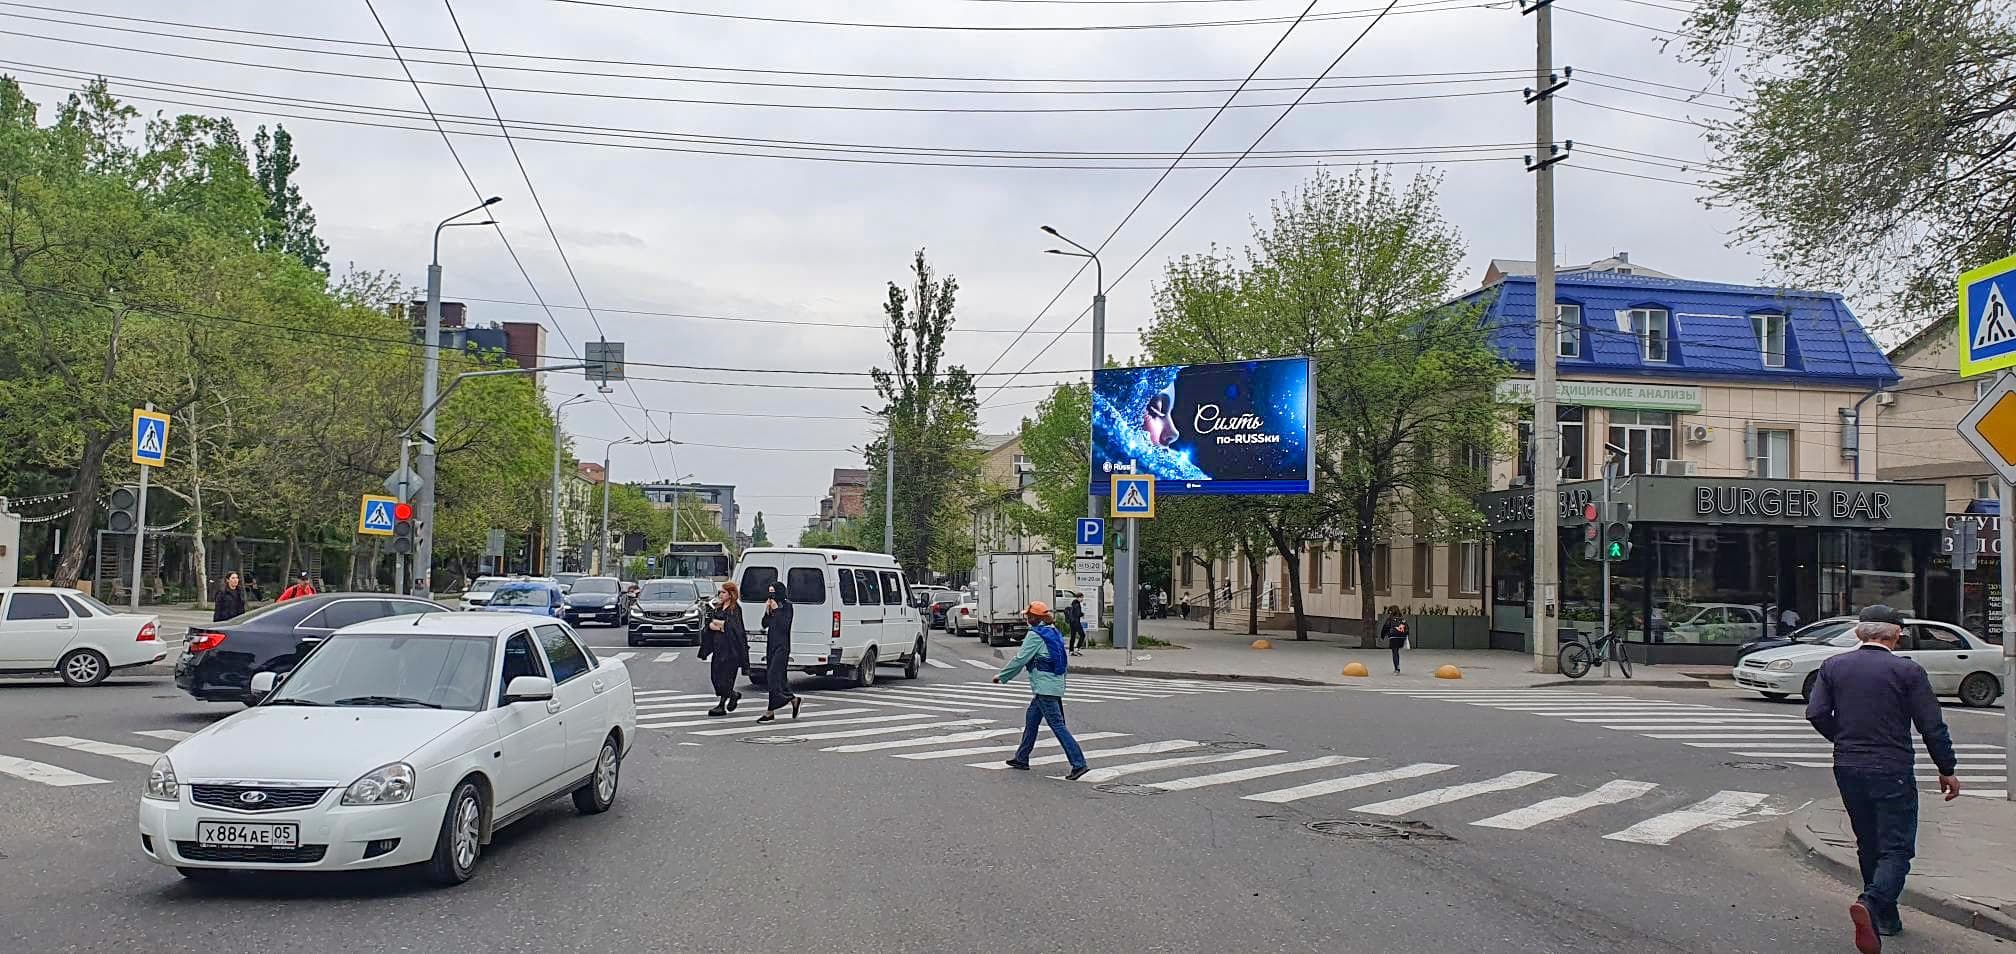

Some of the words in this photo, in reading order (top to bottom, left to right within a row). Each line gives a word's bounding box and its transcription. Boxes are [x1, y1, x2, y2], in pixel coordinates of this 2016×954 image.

[1556, 384, 1633, 398] ЕДИЦИНСКИЕ
[1638, 387, 1696, 400] АНАЛИЗЫ
[1194, 404, 1264, 434] Сиять
[1216, 434, 1280, 444] по-RUSSки
[1500, 495, 1534, 520] BURG
[1697, 487, 1821, 516] BURGER
[1833, 491, 1892, 518] BAR
[1084, 521, 1099, 542] P
[206, 826, 270, 843] Х884АЕ
[274, 827, 291, 839] 05
